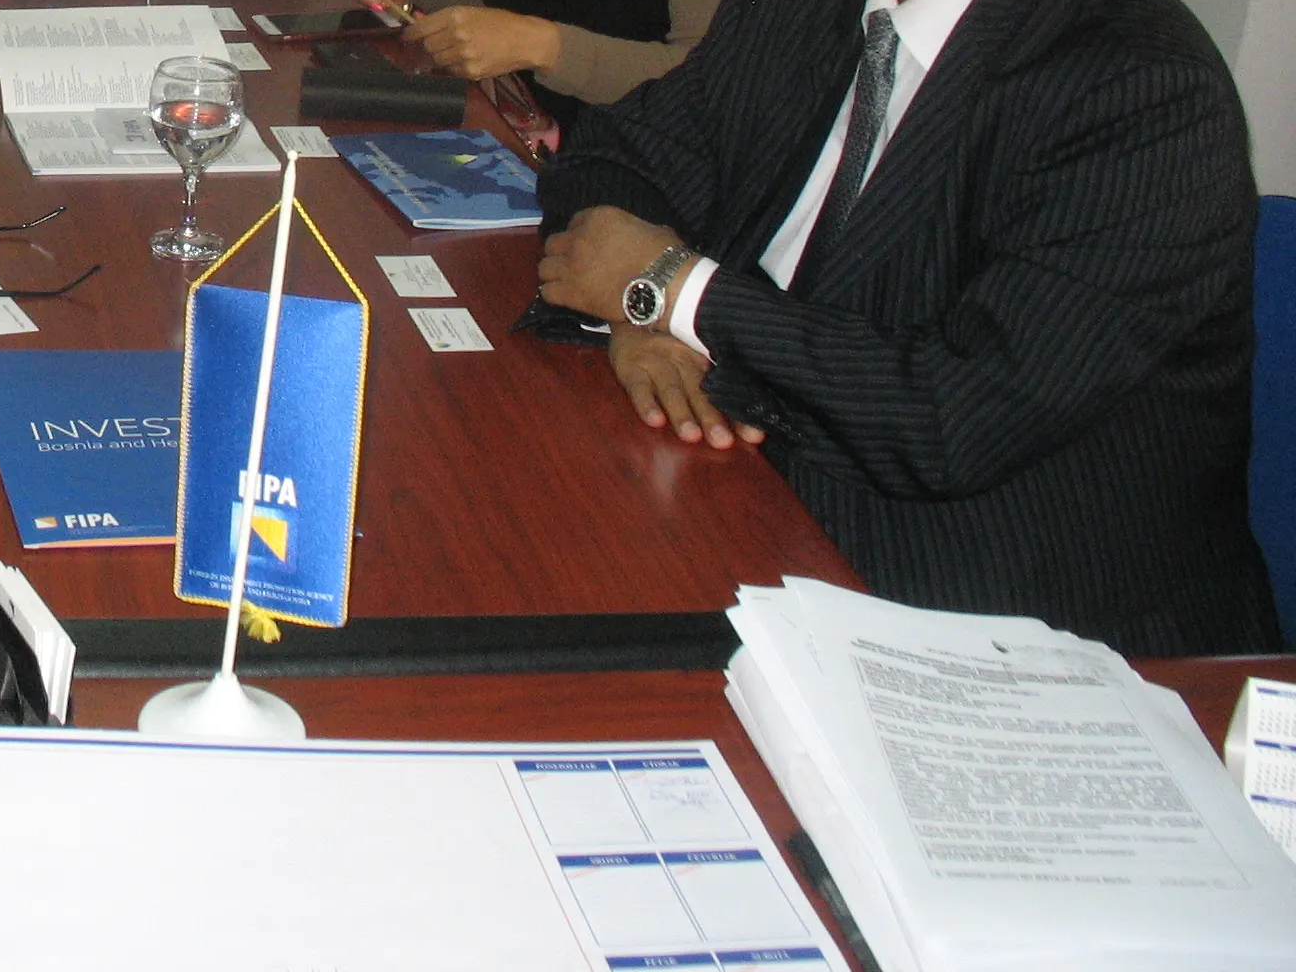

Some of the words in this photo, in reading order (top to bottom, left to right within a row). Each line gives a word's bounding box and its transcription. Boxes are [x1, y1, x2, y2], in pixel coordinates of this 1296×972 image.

[30, 417, 182, 441] INVES
[38, 439, 103, 452] Bosnia
[109, 439, 146, 450] and
[64, 512, 120, 529] FIPA
